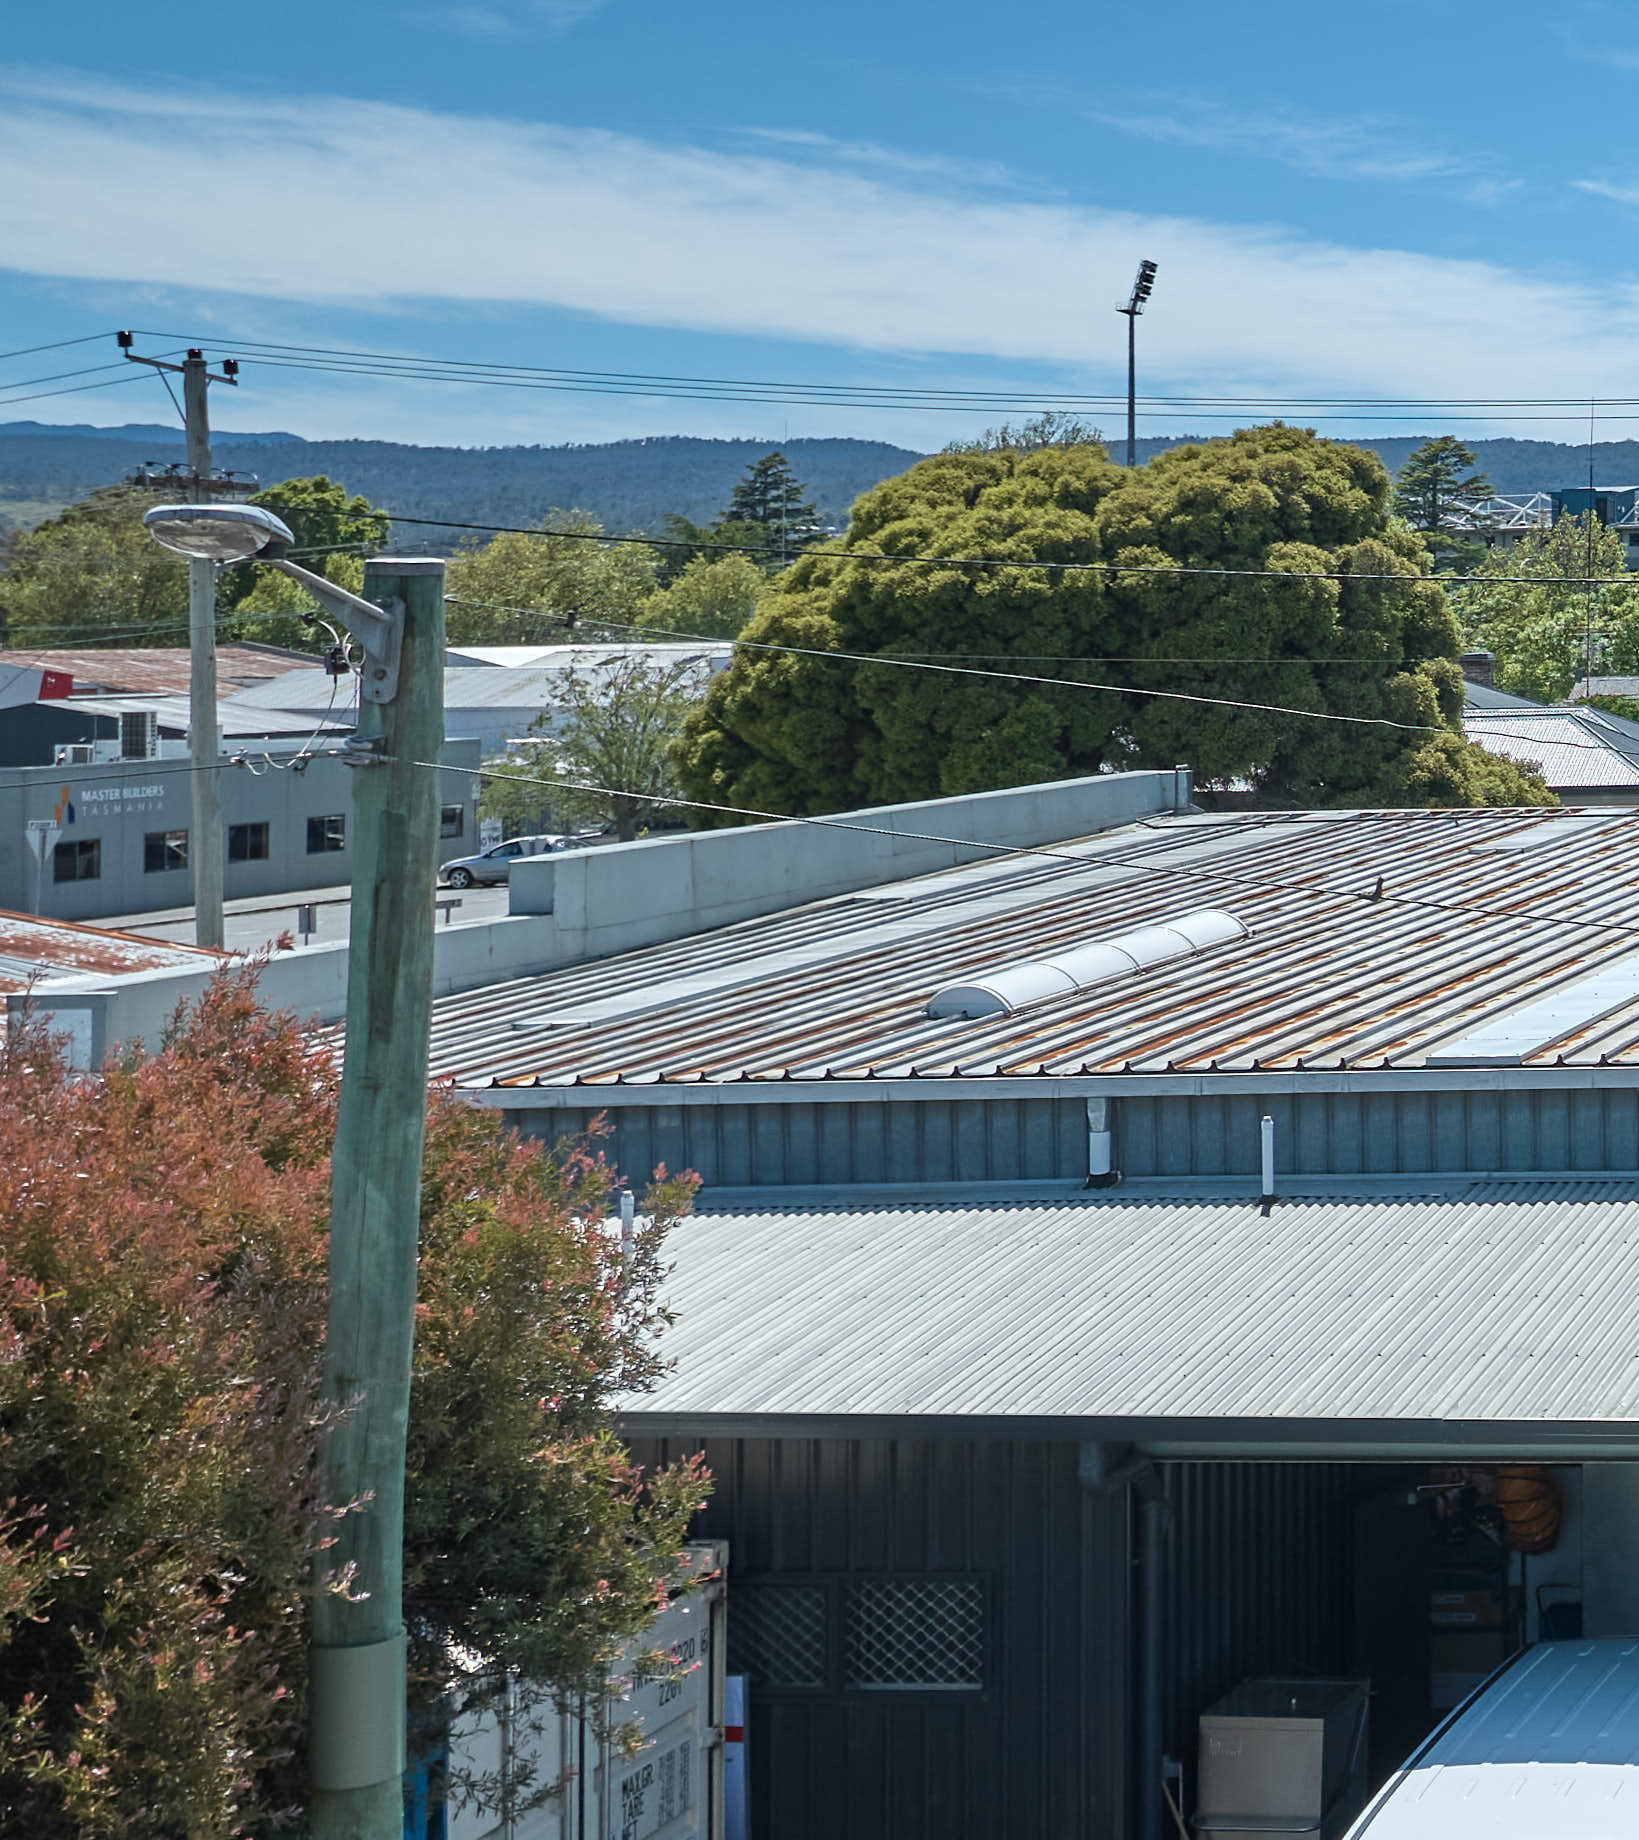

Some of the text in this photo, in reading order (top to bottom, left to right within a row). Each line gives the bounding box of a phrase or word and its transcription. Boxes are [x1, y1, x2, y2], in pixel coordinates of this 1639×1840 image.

[81, 784, 165, 803] MASTER BUILDERS
[82, 801, 165, 817] TASMANIA
[622, 1792, 645, 1825] TARE
